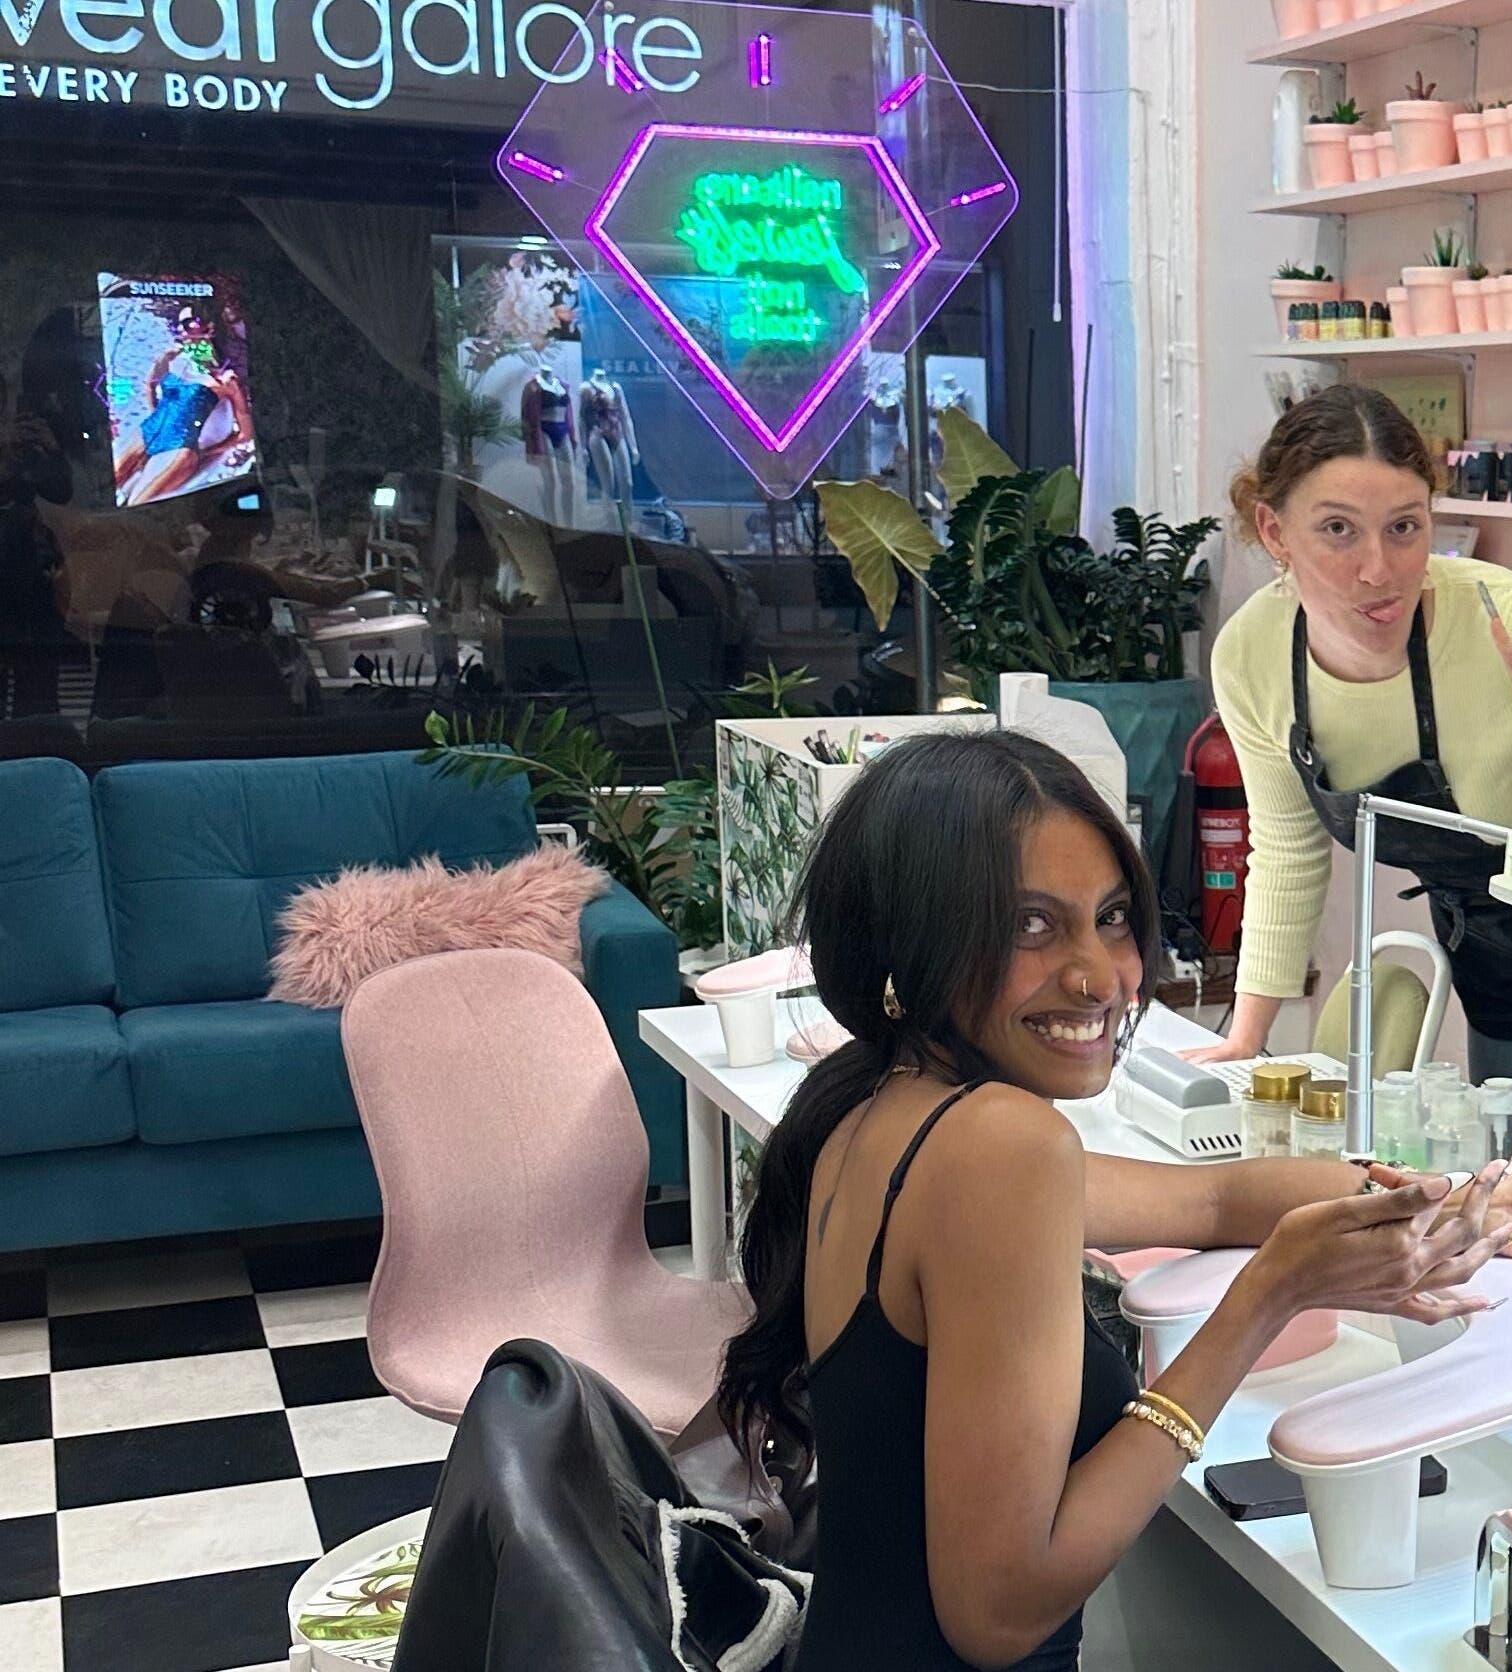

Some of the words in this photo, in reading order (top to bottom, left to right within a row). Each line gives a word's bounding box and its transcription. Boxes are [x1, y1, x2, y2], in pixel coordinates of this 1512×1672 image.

[0, 63, 138, 104] EVERY
[164, 73, 287, 112] BODY
[130, 282, 214, 297] SUNSEEKER
